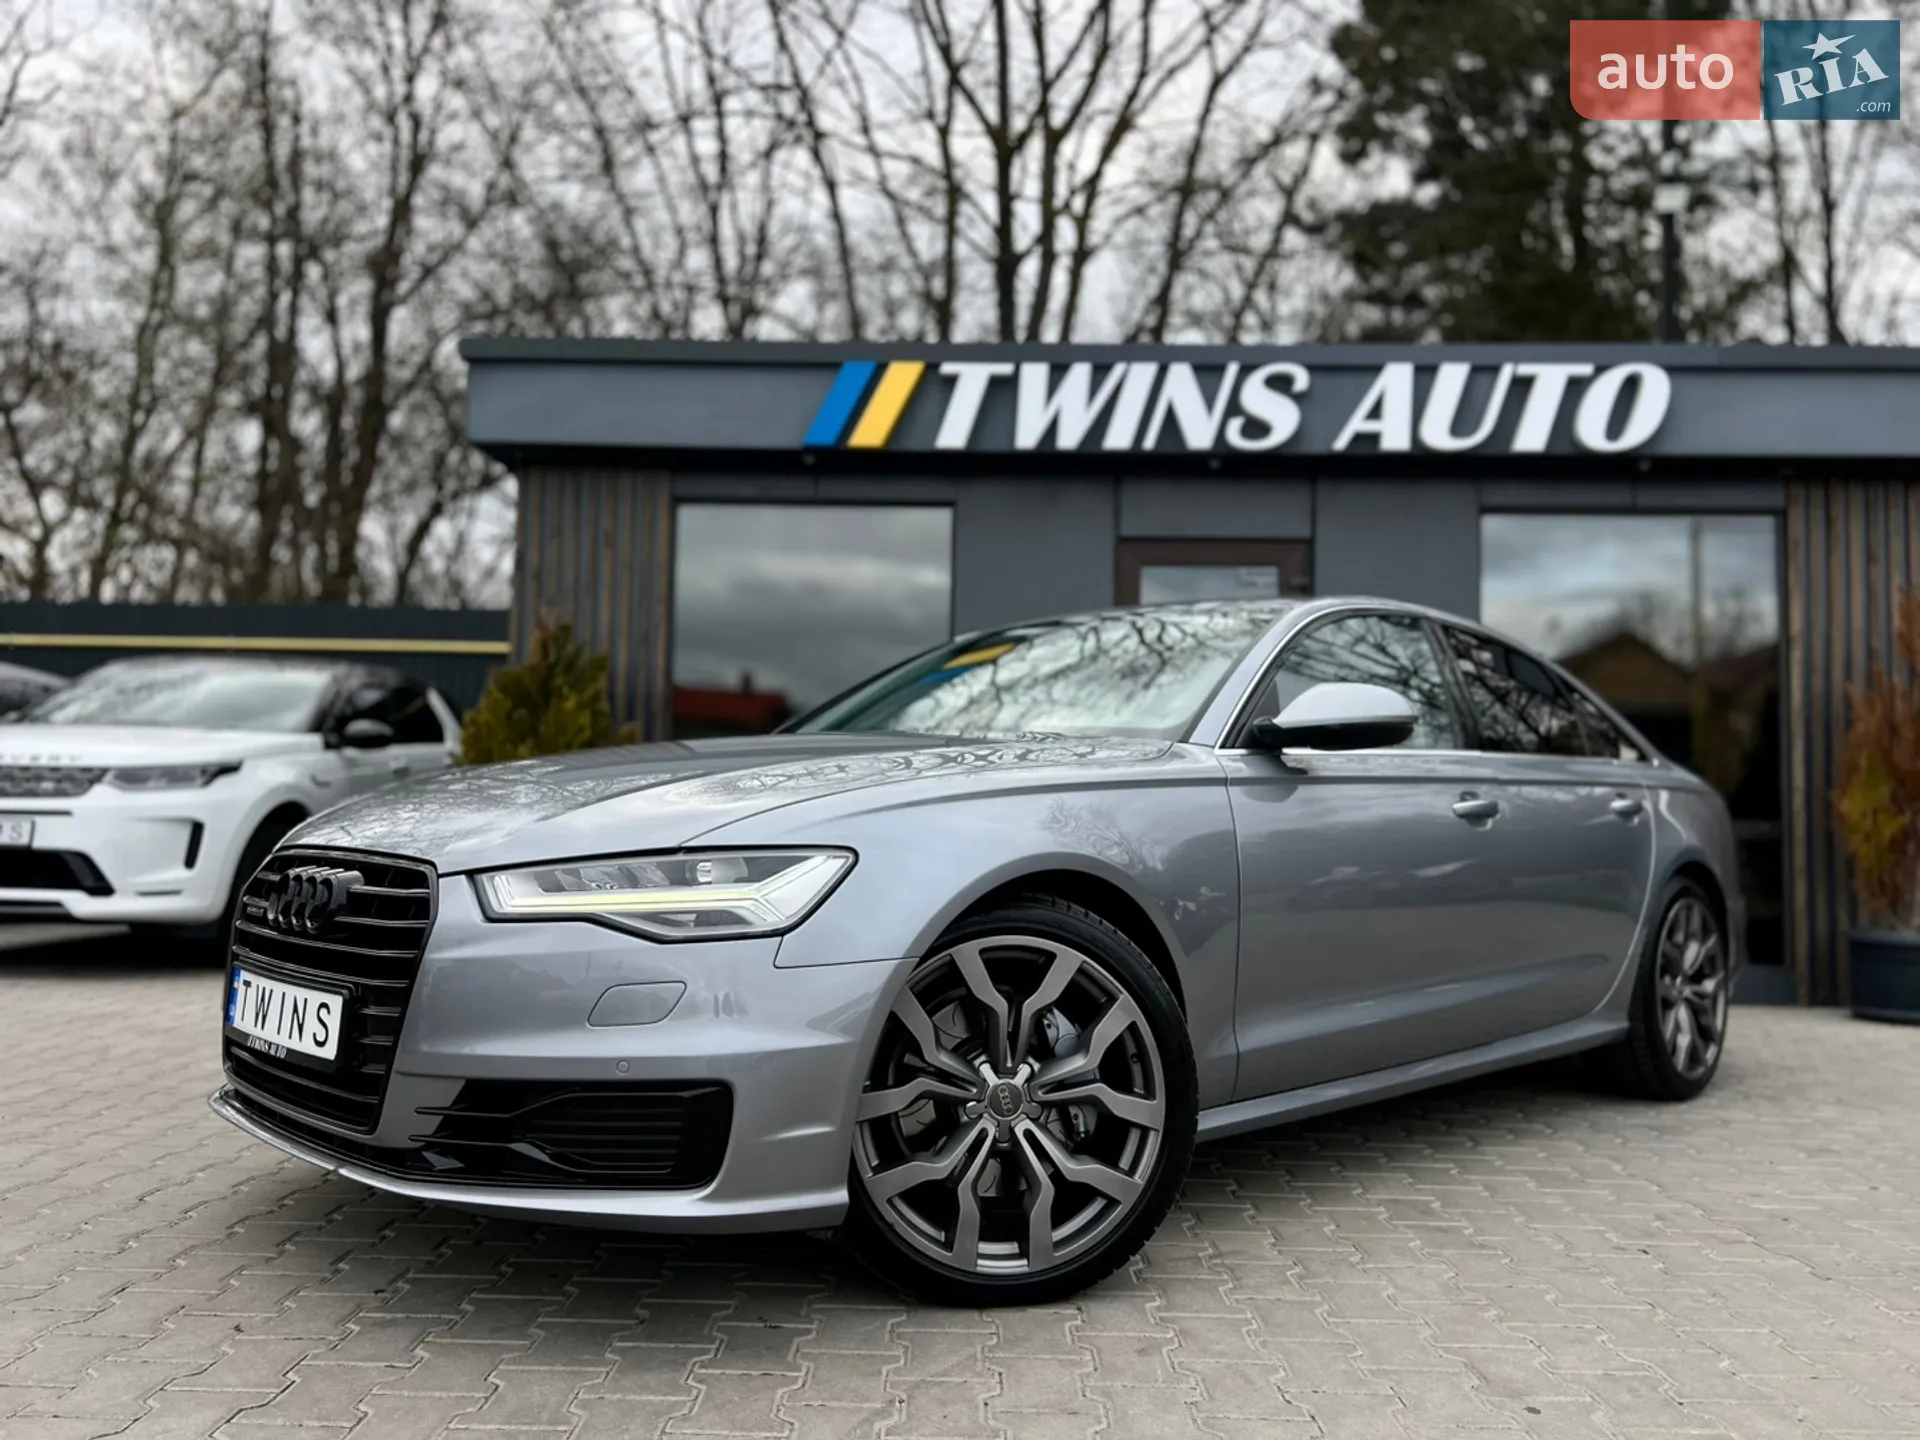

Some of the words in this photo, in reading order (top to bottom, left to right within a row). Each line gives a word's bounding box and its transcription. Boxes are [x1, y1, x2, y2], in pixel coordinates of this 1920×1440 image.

[933, 361, 1311, 452] TWINS
[1331, 361, 1673, 453] AUTO
[240, 979, 331, 1048] TWINS
